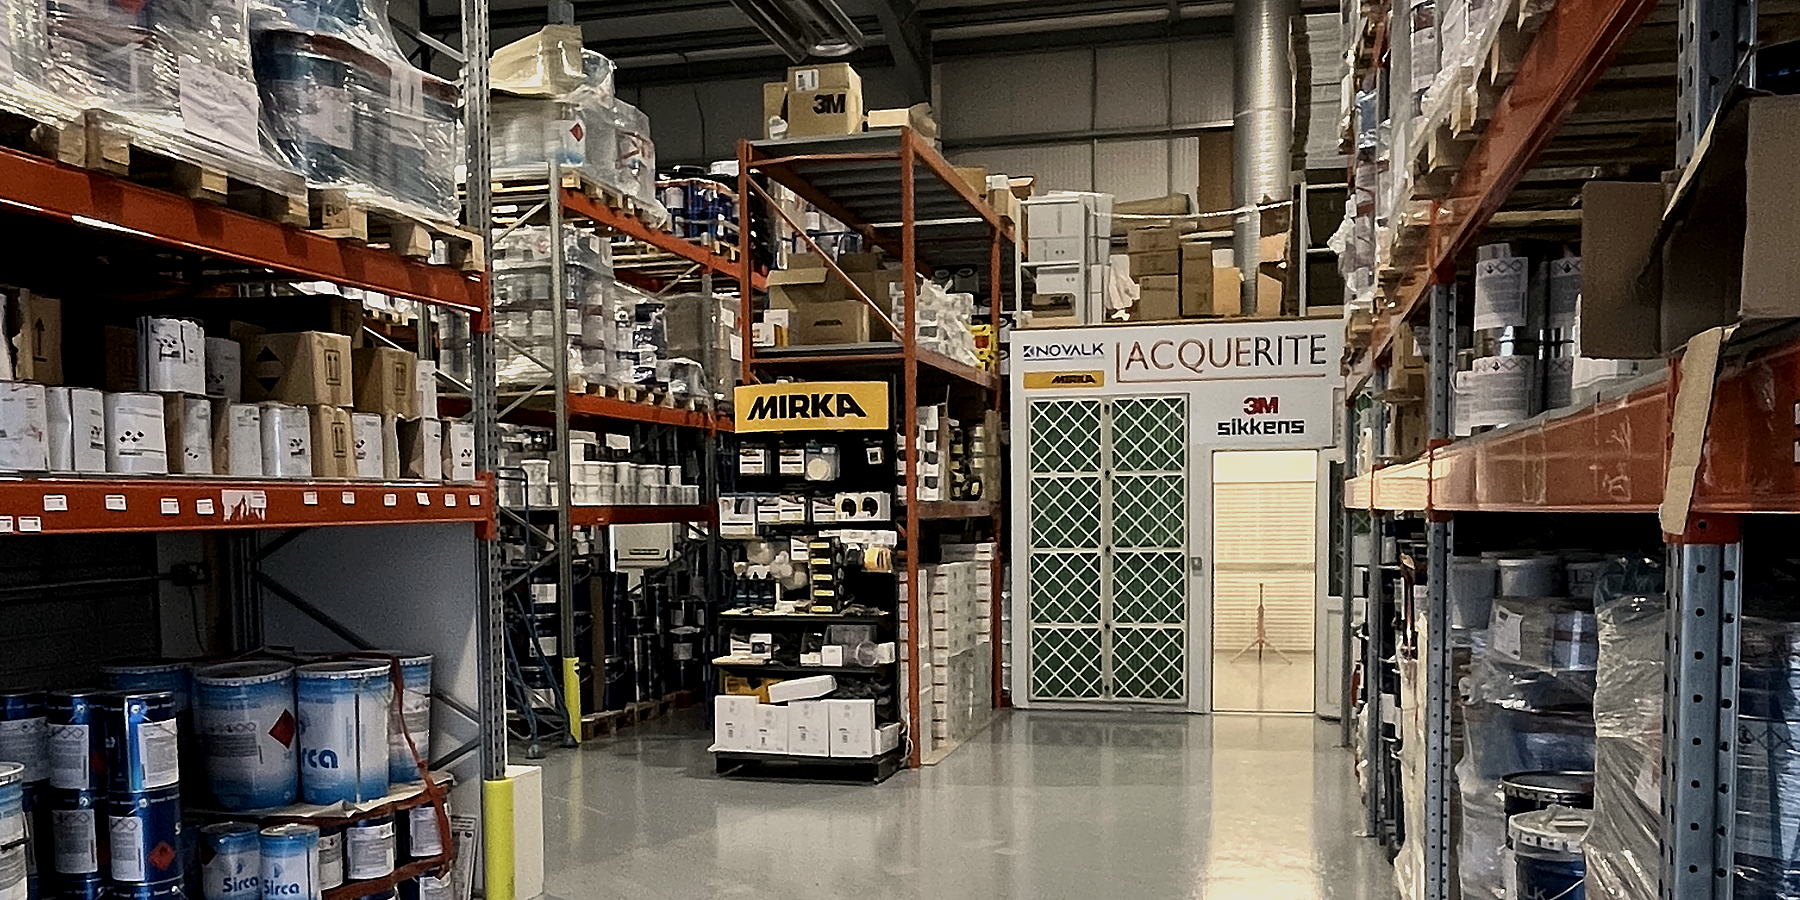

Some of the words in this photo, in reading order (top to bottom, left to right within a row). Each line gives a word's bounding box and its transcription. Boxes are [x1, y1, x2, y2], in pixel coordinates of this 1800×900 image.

[812, 93, 846, 115] 3M
[1036, 342, 1105, 358] NOVALK
[1115, 333, 1327, 383] LACQUERITE
[746, 393, 867, 420] MIRKA
[1243, 396, 1279, 415] 3M
[1217, 418, 1305, 436] sikkens
[302, 748, 339, 769] rca
[222, 875, 259, 893] Sirca
[263, 879, 299, 895] Sirca
